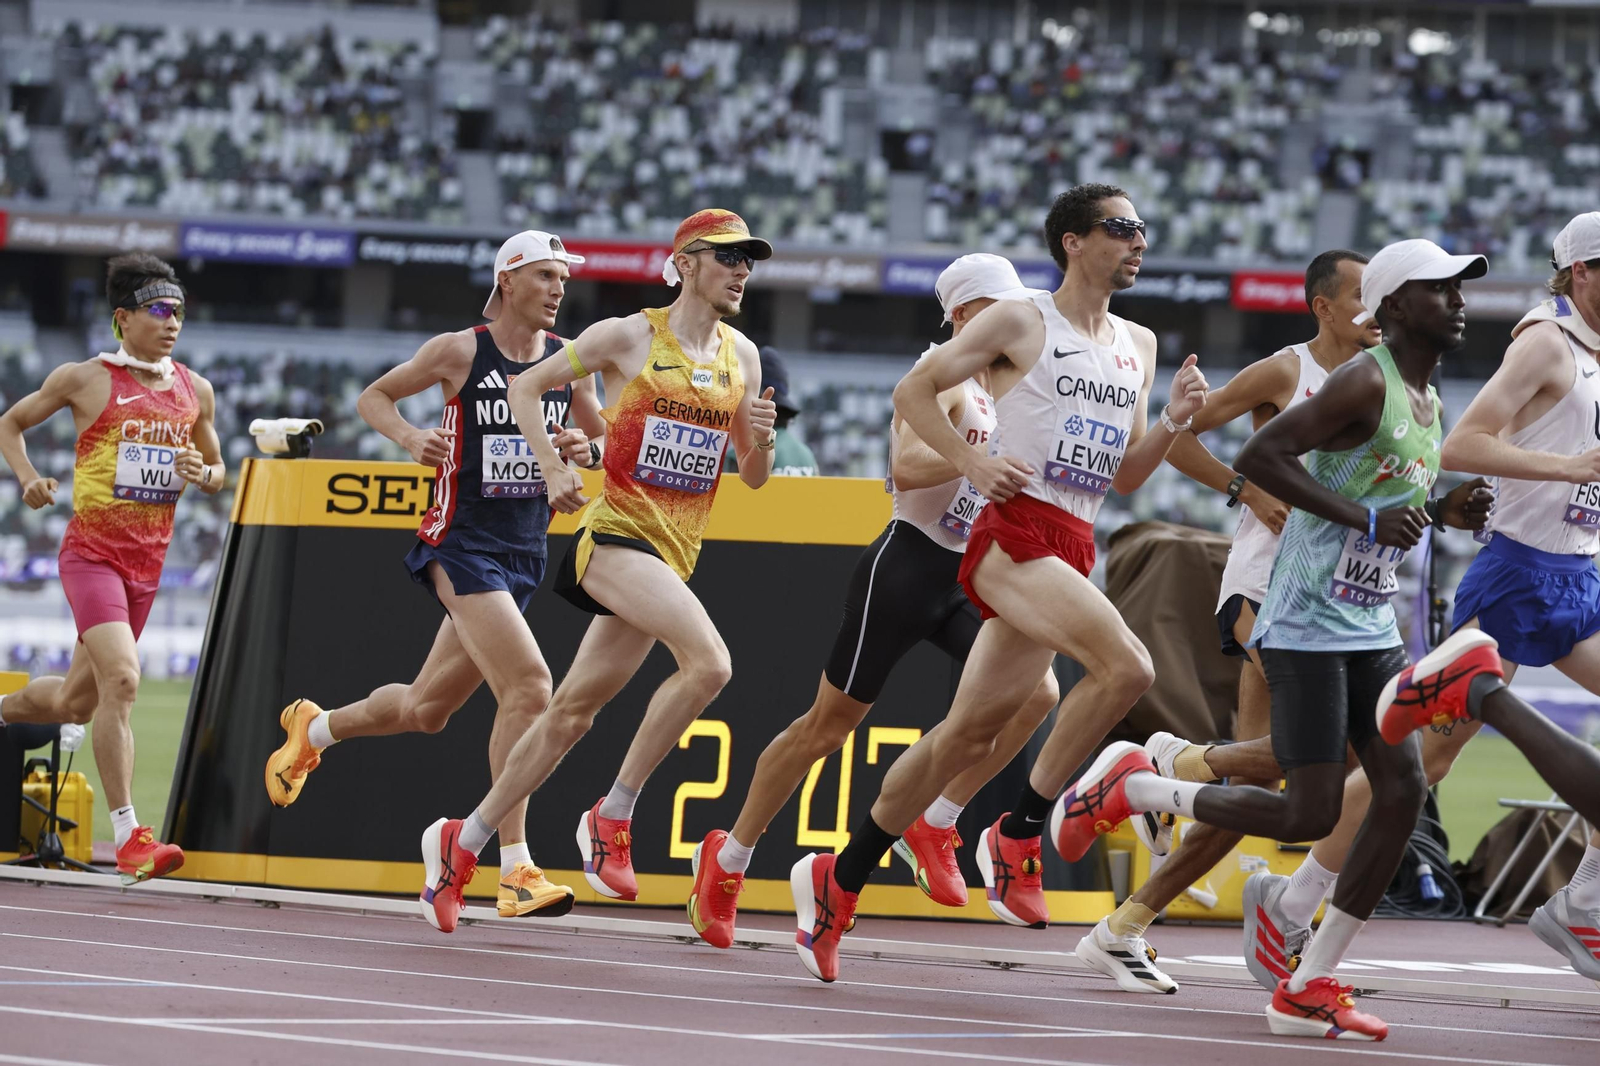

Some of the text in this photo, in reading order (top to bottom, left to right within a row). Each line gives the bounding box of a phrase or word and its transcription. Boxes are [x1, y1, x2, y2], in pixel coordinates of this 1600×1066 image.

[692, 373, 712, 383] WGV
[1056, 375, 1137, 411] CANADA
[654, 397, 733, 427] GERMANY
[121, 419, 191, 445] CHINA
[672, 423, 721, 452] TDK
[1085, 418, 1129, 450] TDK
[141, 447, 178, 466] TD
[644, 444, 716, 476] RINGER
[1056, 440, 1121, 477] LEVINS
[141, 468, 172, 488] WU
[491, 462, 544, 480] MOE
[954, 496, 983, 521] SIN
[1575, 483, 1600, 508] FIS
